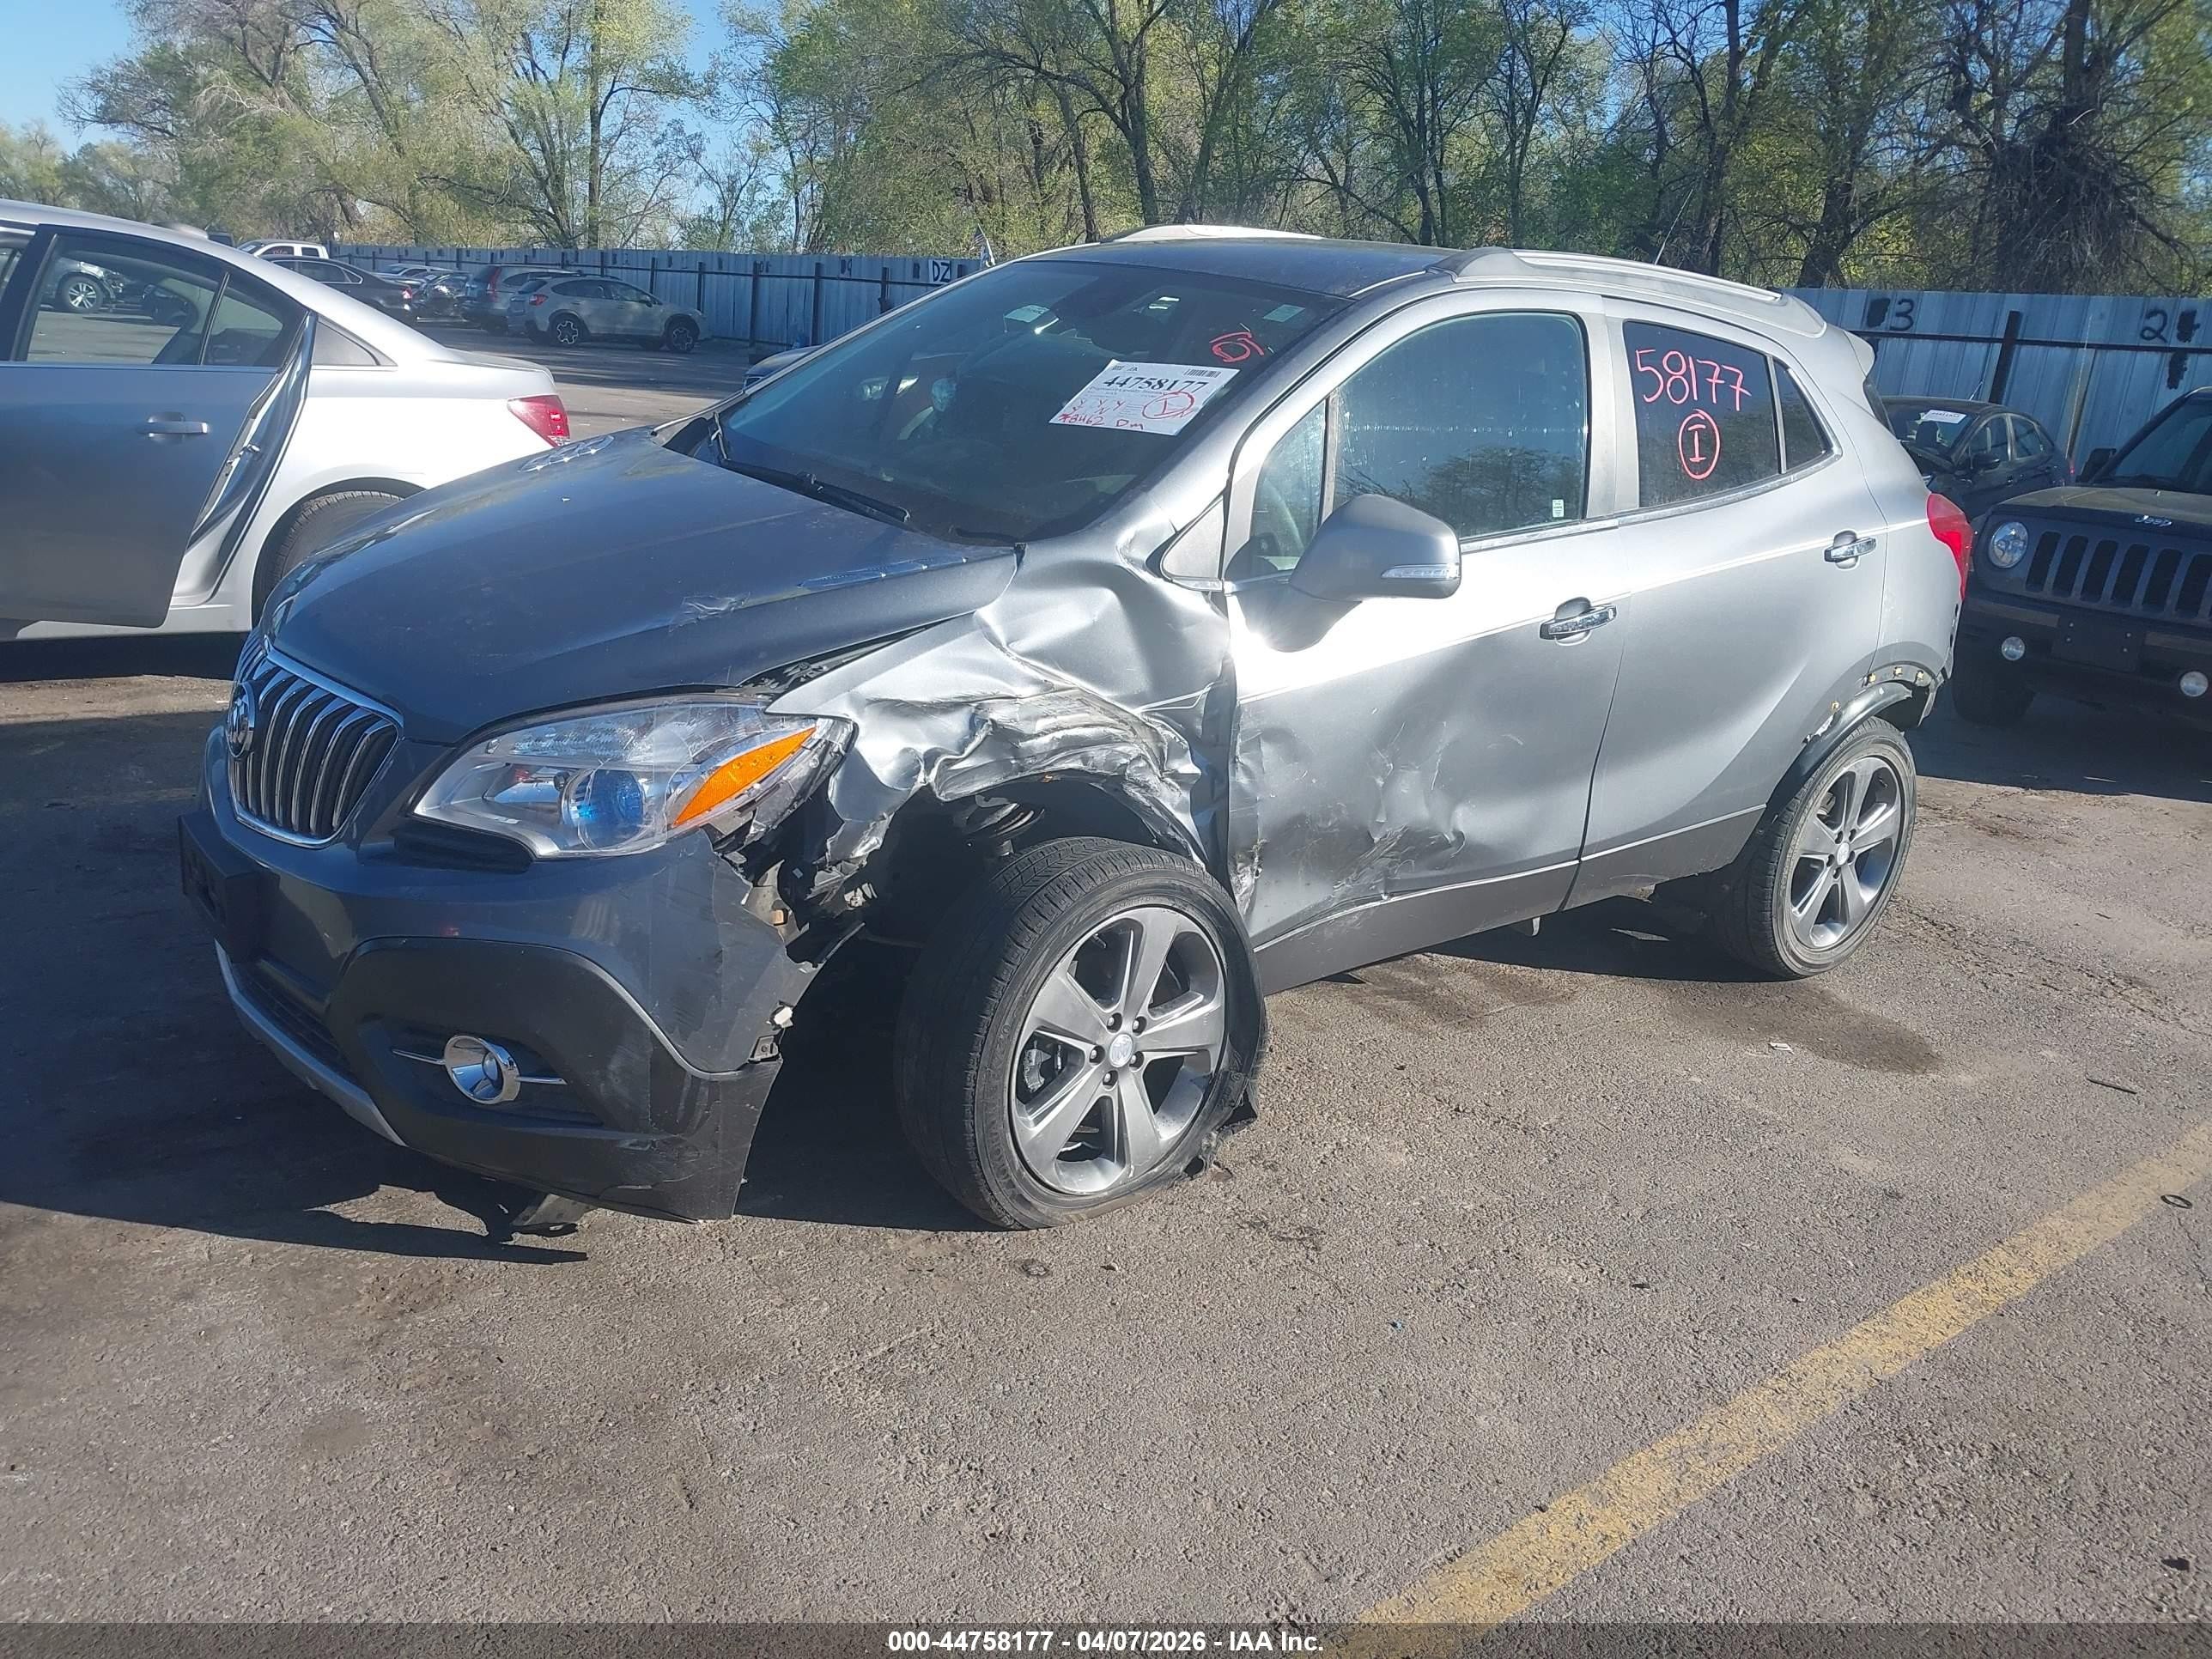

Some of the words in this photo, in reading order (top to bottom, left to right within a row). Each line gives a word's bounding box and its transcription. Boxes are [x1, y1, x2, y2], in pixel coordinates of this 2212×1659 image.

[1889, 298, 1915, 331] 3
[2140, 309, 2169, 343] 2
[1103, 375, 1209, 393] 44758177
[1635, 349, 1753, 411] 58177
[2134, 515, 2172, 527] Jeep
